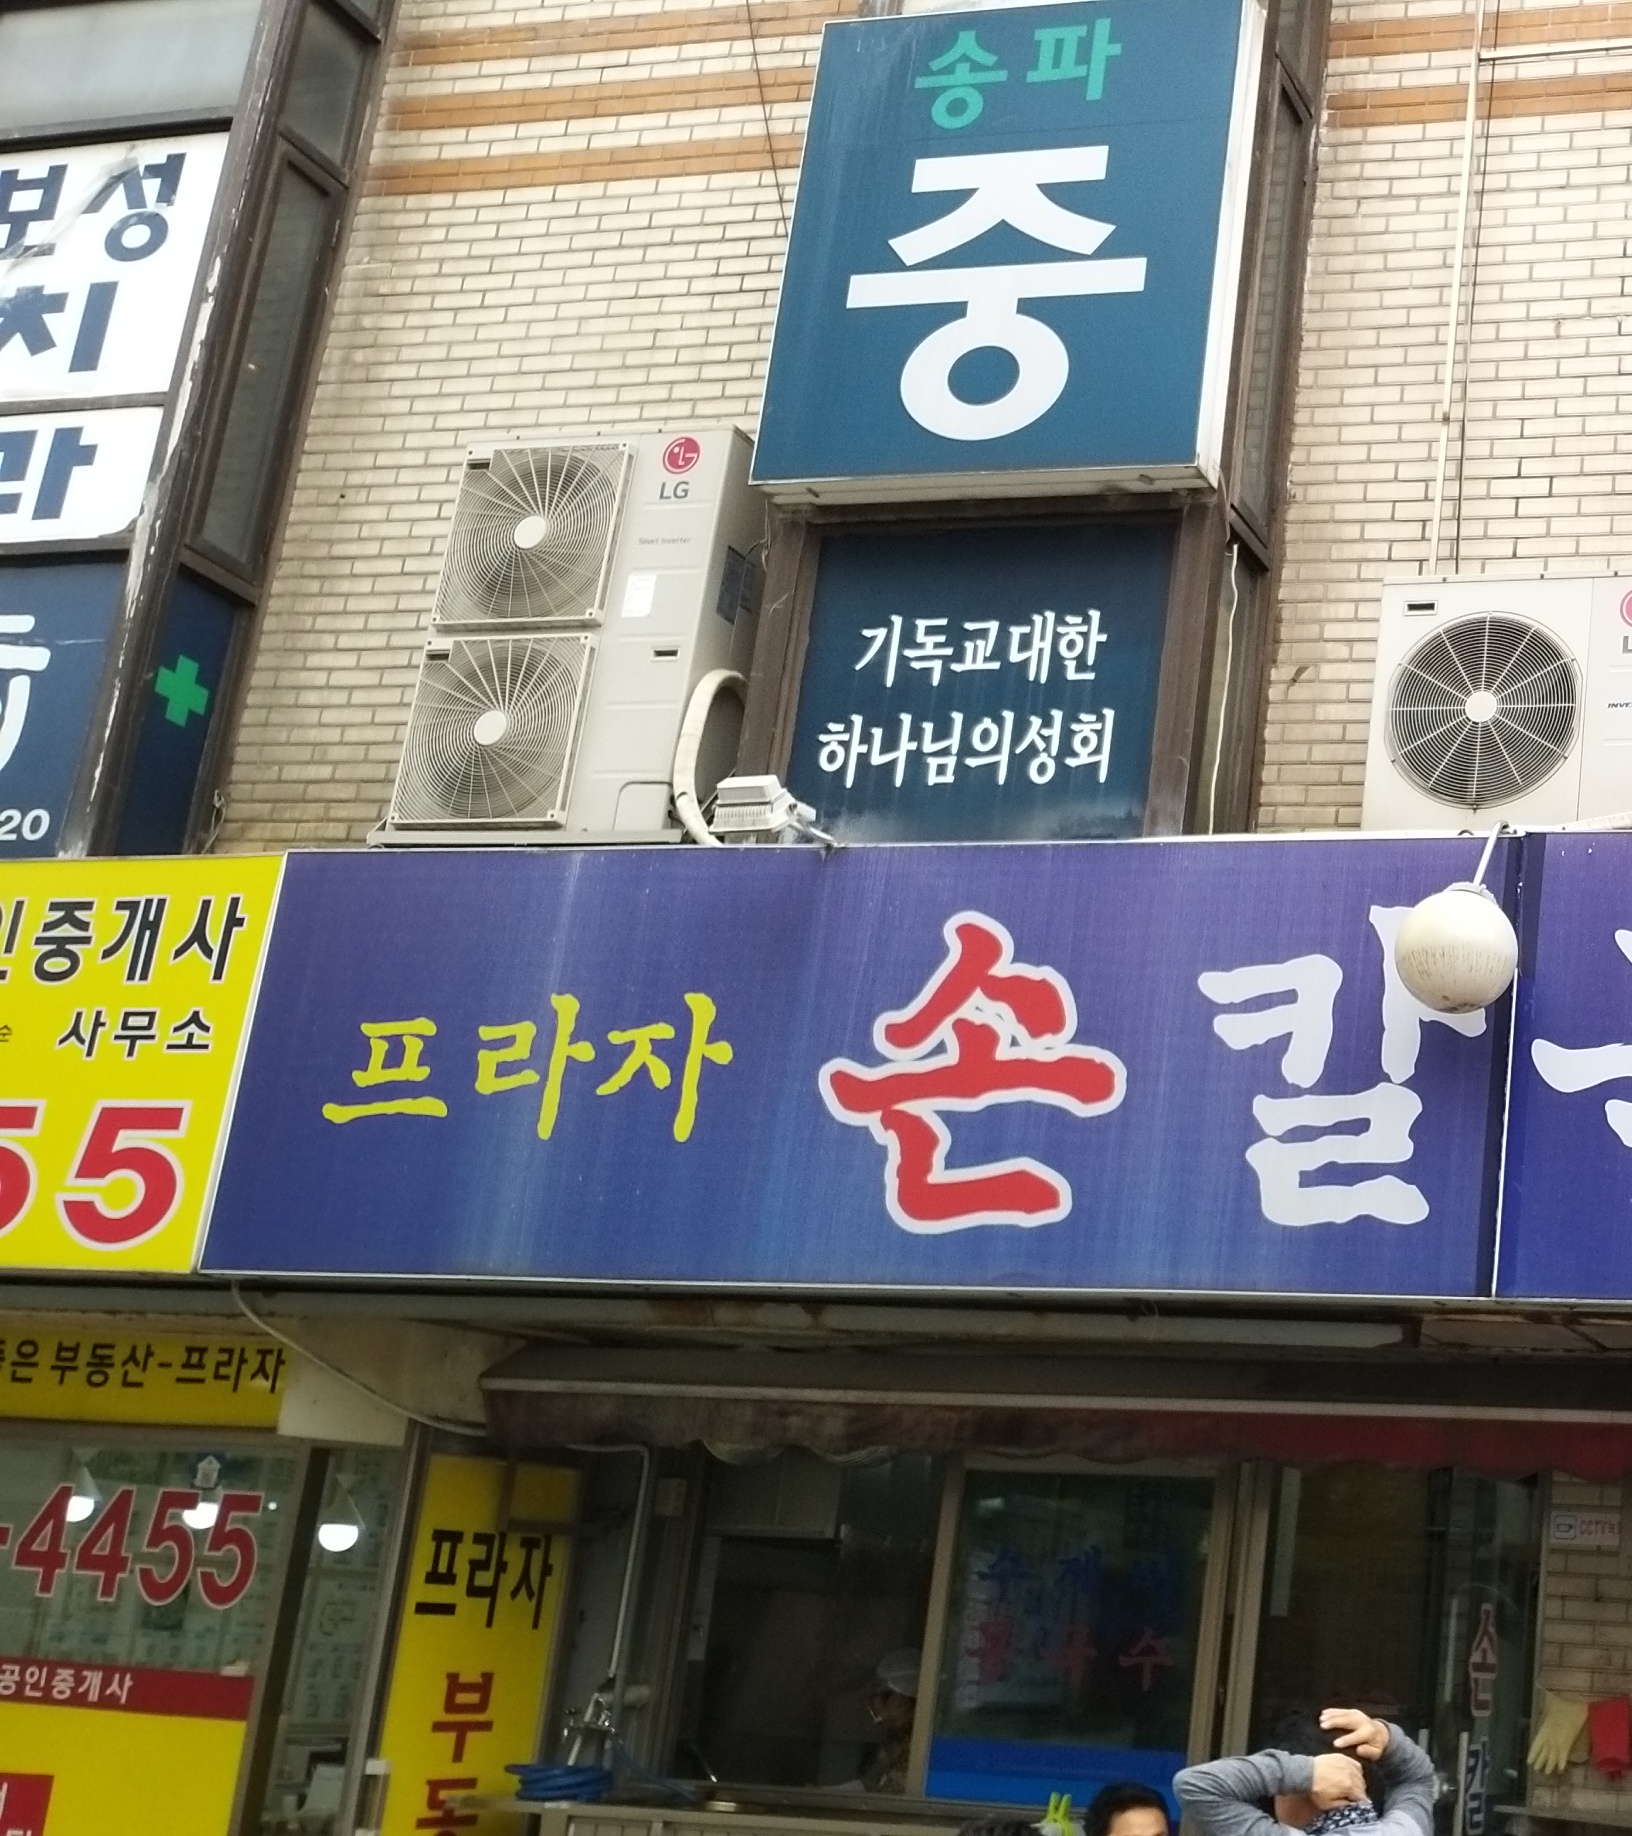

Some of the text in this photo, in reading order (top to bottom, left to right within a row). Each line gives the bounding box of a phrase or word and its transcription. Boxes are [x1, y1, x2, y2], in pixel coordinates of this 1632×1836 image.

[914, 18, 1121, 130] 송파
[846, 145, 1147, 441] 중
[659, 481, 690, 500] LG
[853, 609, 1107, 687] 기독교대한
[816, 708, 1116, 789] 하나님의성회
[55, 1007, 214, 1060] 사무소
[321, 992, 733, 1142] 프라자
[0, 1339, 39, 1383] 은
[414, 1529, 553, 1630] 프라자
[0, 1663, 133, 1704] 공인중개사
